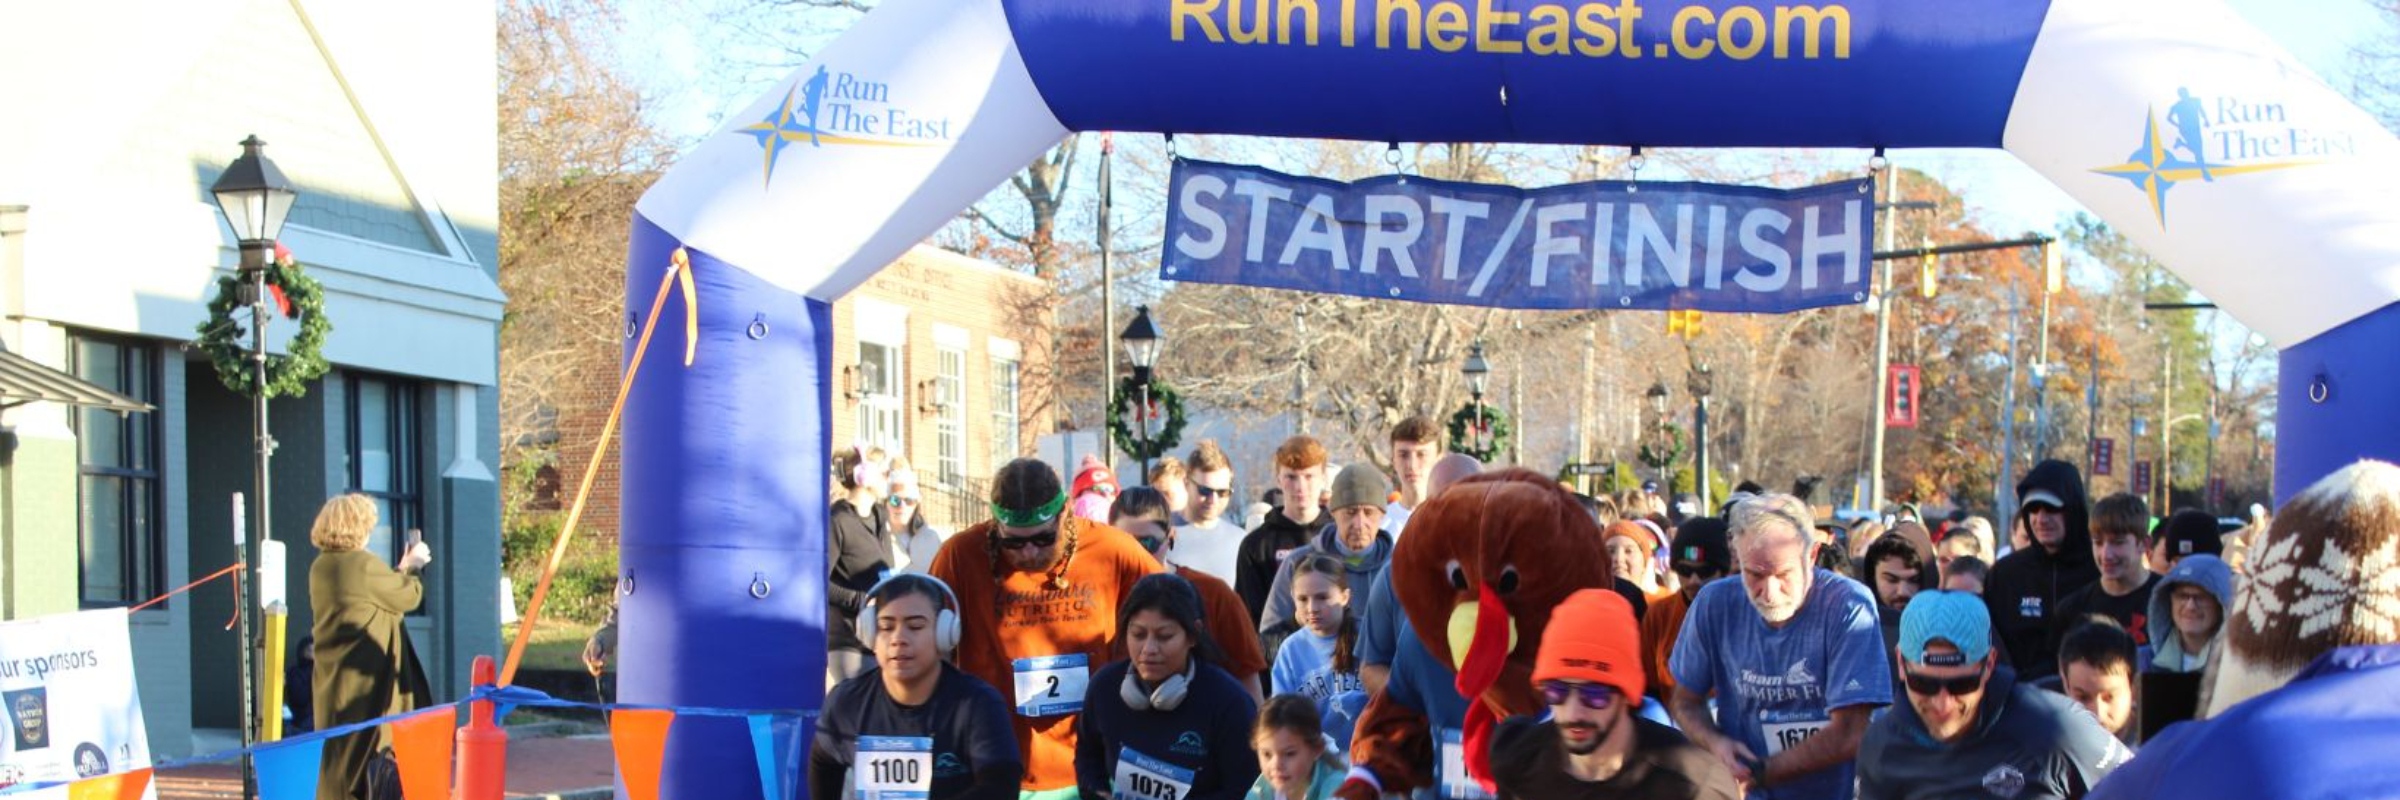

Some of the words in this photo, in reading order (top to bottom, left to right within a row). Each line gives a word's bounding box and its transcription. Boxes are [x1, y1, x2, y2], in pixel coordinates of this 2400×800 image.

[833, 72, 888, 103] Run
[826, 102, 879, 135] The
[886, 109, 950, 140] East
[2216, 95, 2286, 126] Run
[2213, 128, 2280, 161] The
[1174, 172, 1863, 297] START/FINISH
[0, 660, 21, 678] ur
[25, 650, 98, 680] sponsors
[1741, 669, 1783, 686] Team
[1047, 675, 1060, 698] 2
[1735, 677, 1798, 703] SEMPER
[871, 758, 919, 784] 1100
[1128, 772, 1177, 800] 1073
